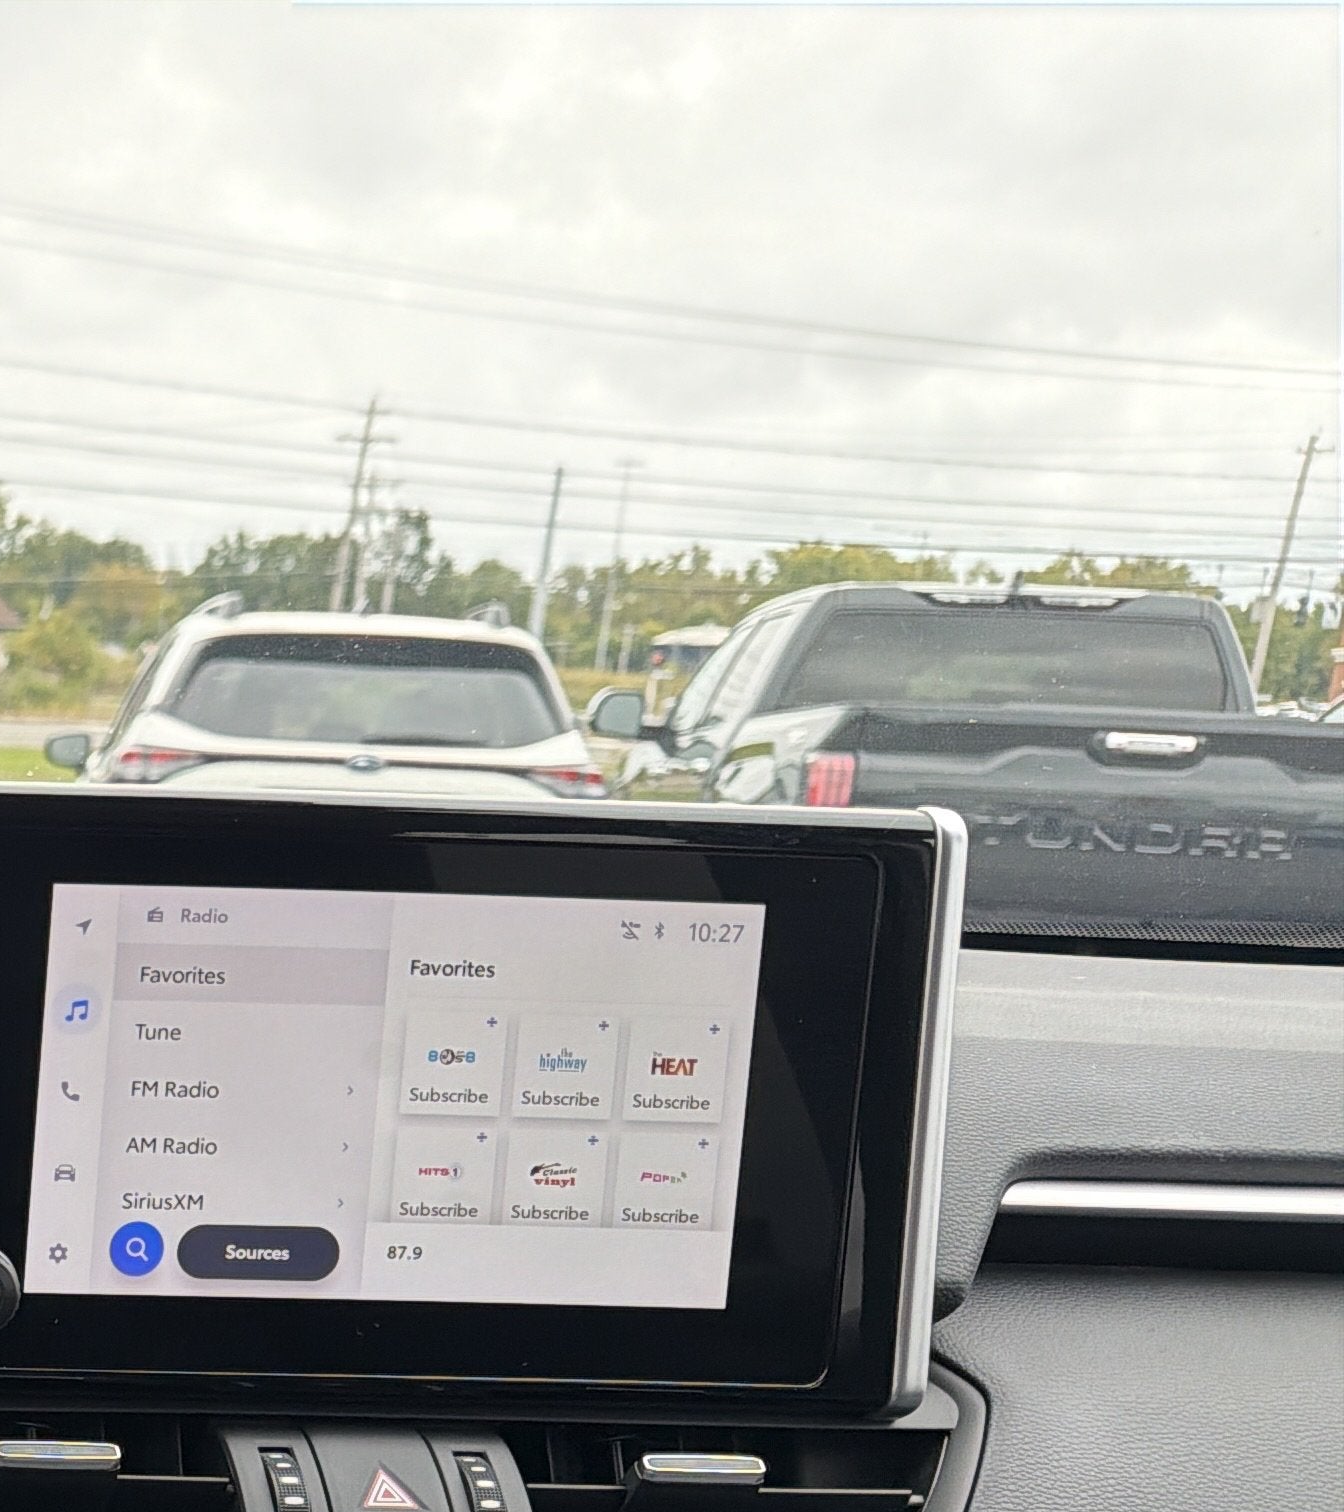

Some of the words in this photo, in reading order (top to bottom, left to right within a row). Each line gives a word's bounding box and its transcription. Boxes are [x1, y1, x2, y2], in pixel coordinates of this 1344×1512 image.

[180, 906, 229, 924] Radio
[688, 922, 745, 943] 10:27
[139, 965, 226, 985] Favorites
[409, 959, 496, 979] Favorites
[134, 1022, 182, 1041] Tune
[538, 1053, 587, 1072] highway
[650, 1057, 698, 1076] HEAT
[130, 1080, 159, 1098] FM
[164, 1080, 220, 1099] Radio
[408, 1086, 489, 1105] Subscribe
[521, 1090, 600, 1107] Subscribe
[631, 1093, 711, 1111] Subscribe
[125, 1137, 157, 1154] AM
[162, 1137, 218, 1155] Radio
[533, 1176, 576, 1188] vinyl
[121, 1191, 205, 1211] SiriusXM
[398, 1201, 479, 1219] Subscribe
[510, 1204, 590, 1222] Subscribe
[621, 1207, 700, 1225] Subscribe
[224, 1243, 291, 1262] Sources
[386, 1244, 423, 1261] 87.9
